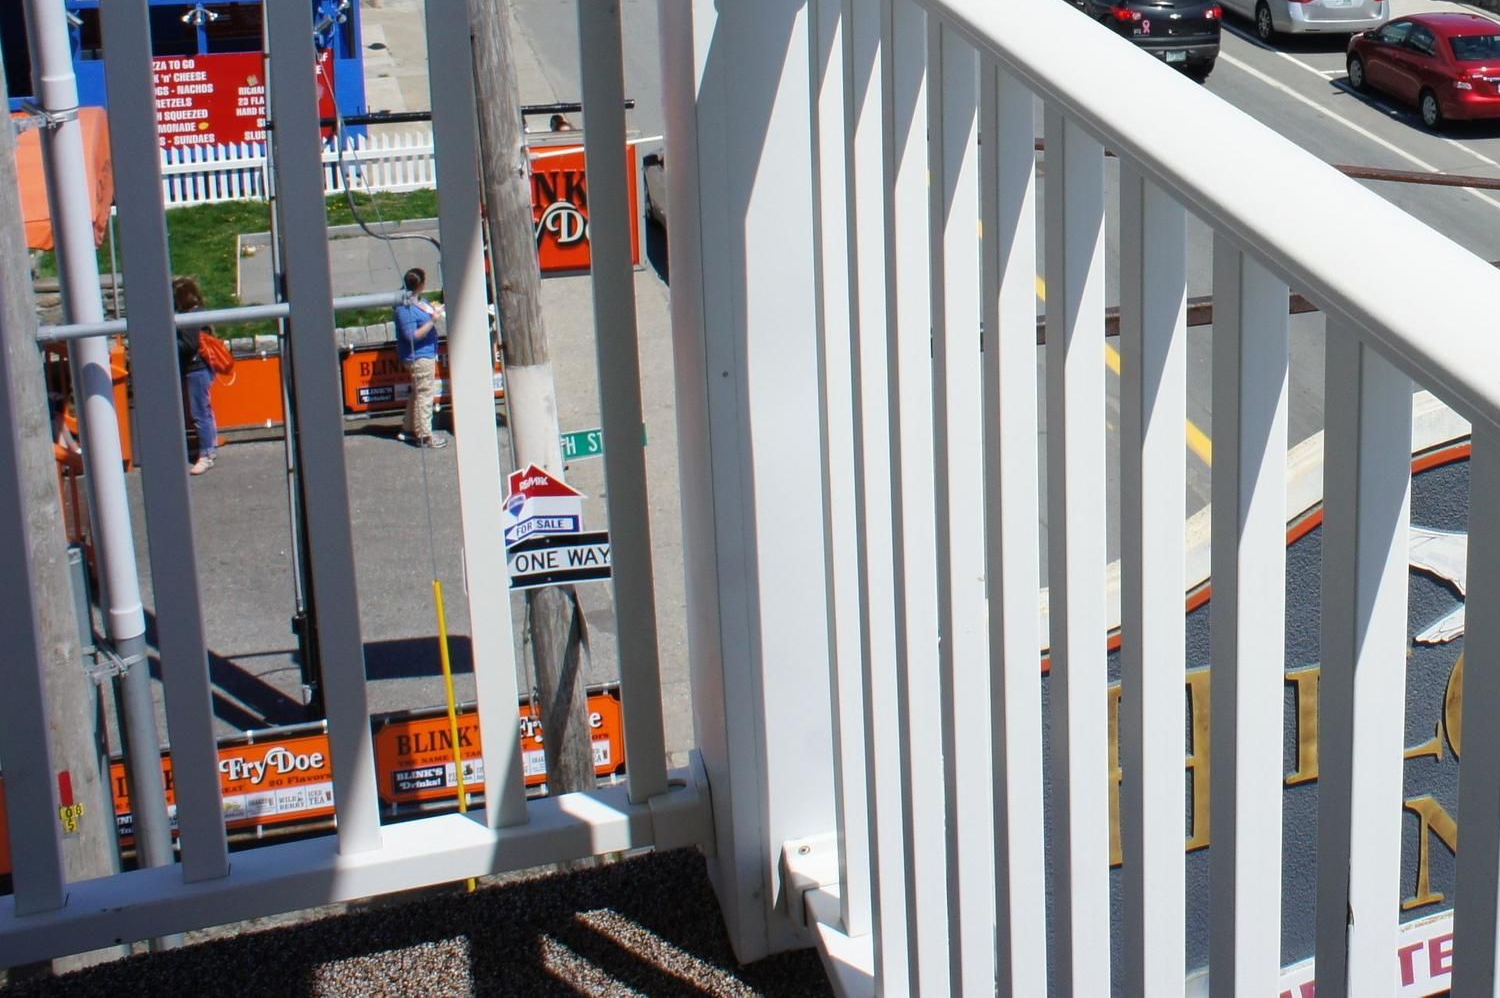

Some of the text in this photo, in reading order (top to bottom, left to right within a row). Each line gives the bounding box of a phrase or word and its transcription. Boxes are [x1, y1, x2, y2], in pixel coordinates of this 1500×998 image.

[168, 60, 180, 70] TO
[182, 59, 195, 69] GO
[173, 71, 207, 82] CHEESE
[177, 83, 214, 95] NACHOS
[156, 97, 192, 108] RETZELS
[250, 96, 265, 105] FLA
[164, 109, 208, 121] SQUEEZED
[236, 107, 258, 117] HARD
[158, 122, 196, 133] MONADE
[173, 133, 215, 145] SUNDAES
[516, 519, 564, 536] FOR SALE
[515, 543, 610, 572] ONE WAY
[396, 725, 478, 756] BLINK'
[396, 767, 443, 781] BLINK'S
